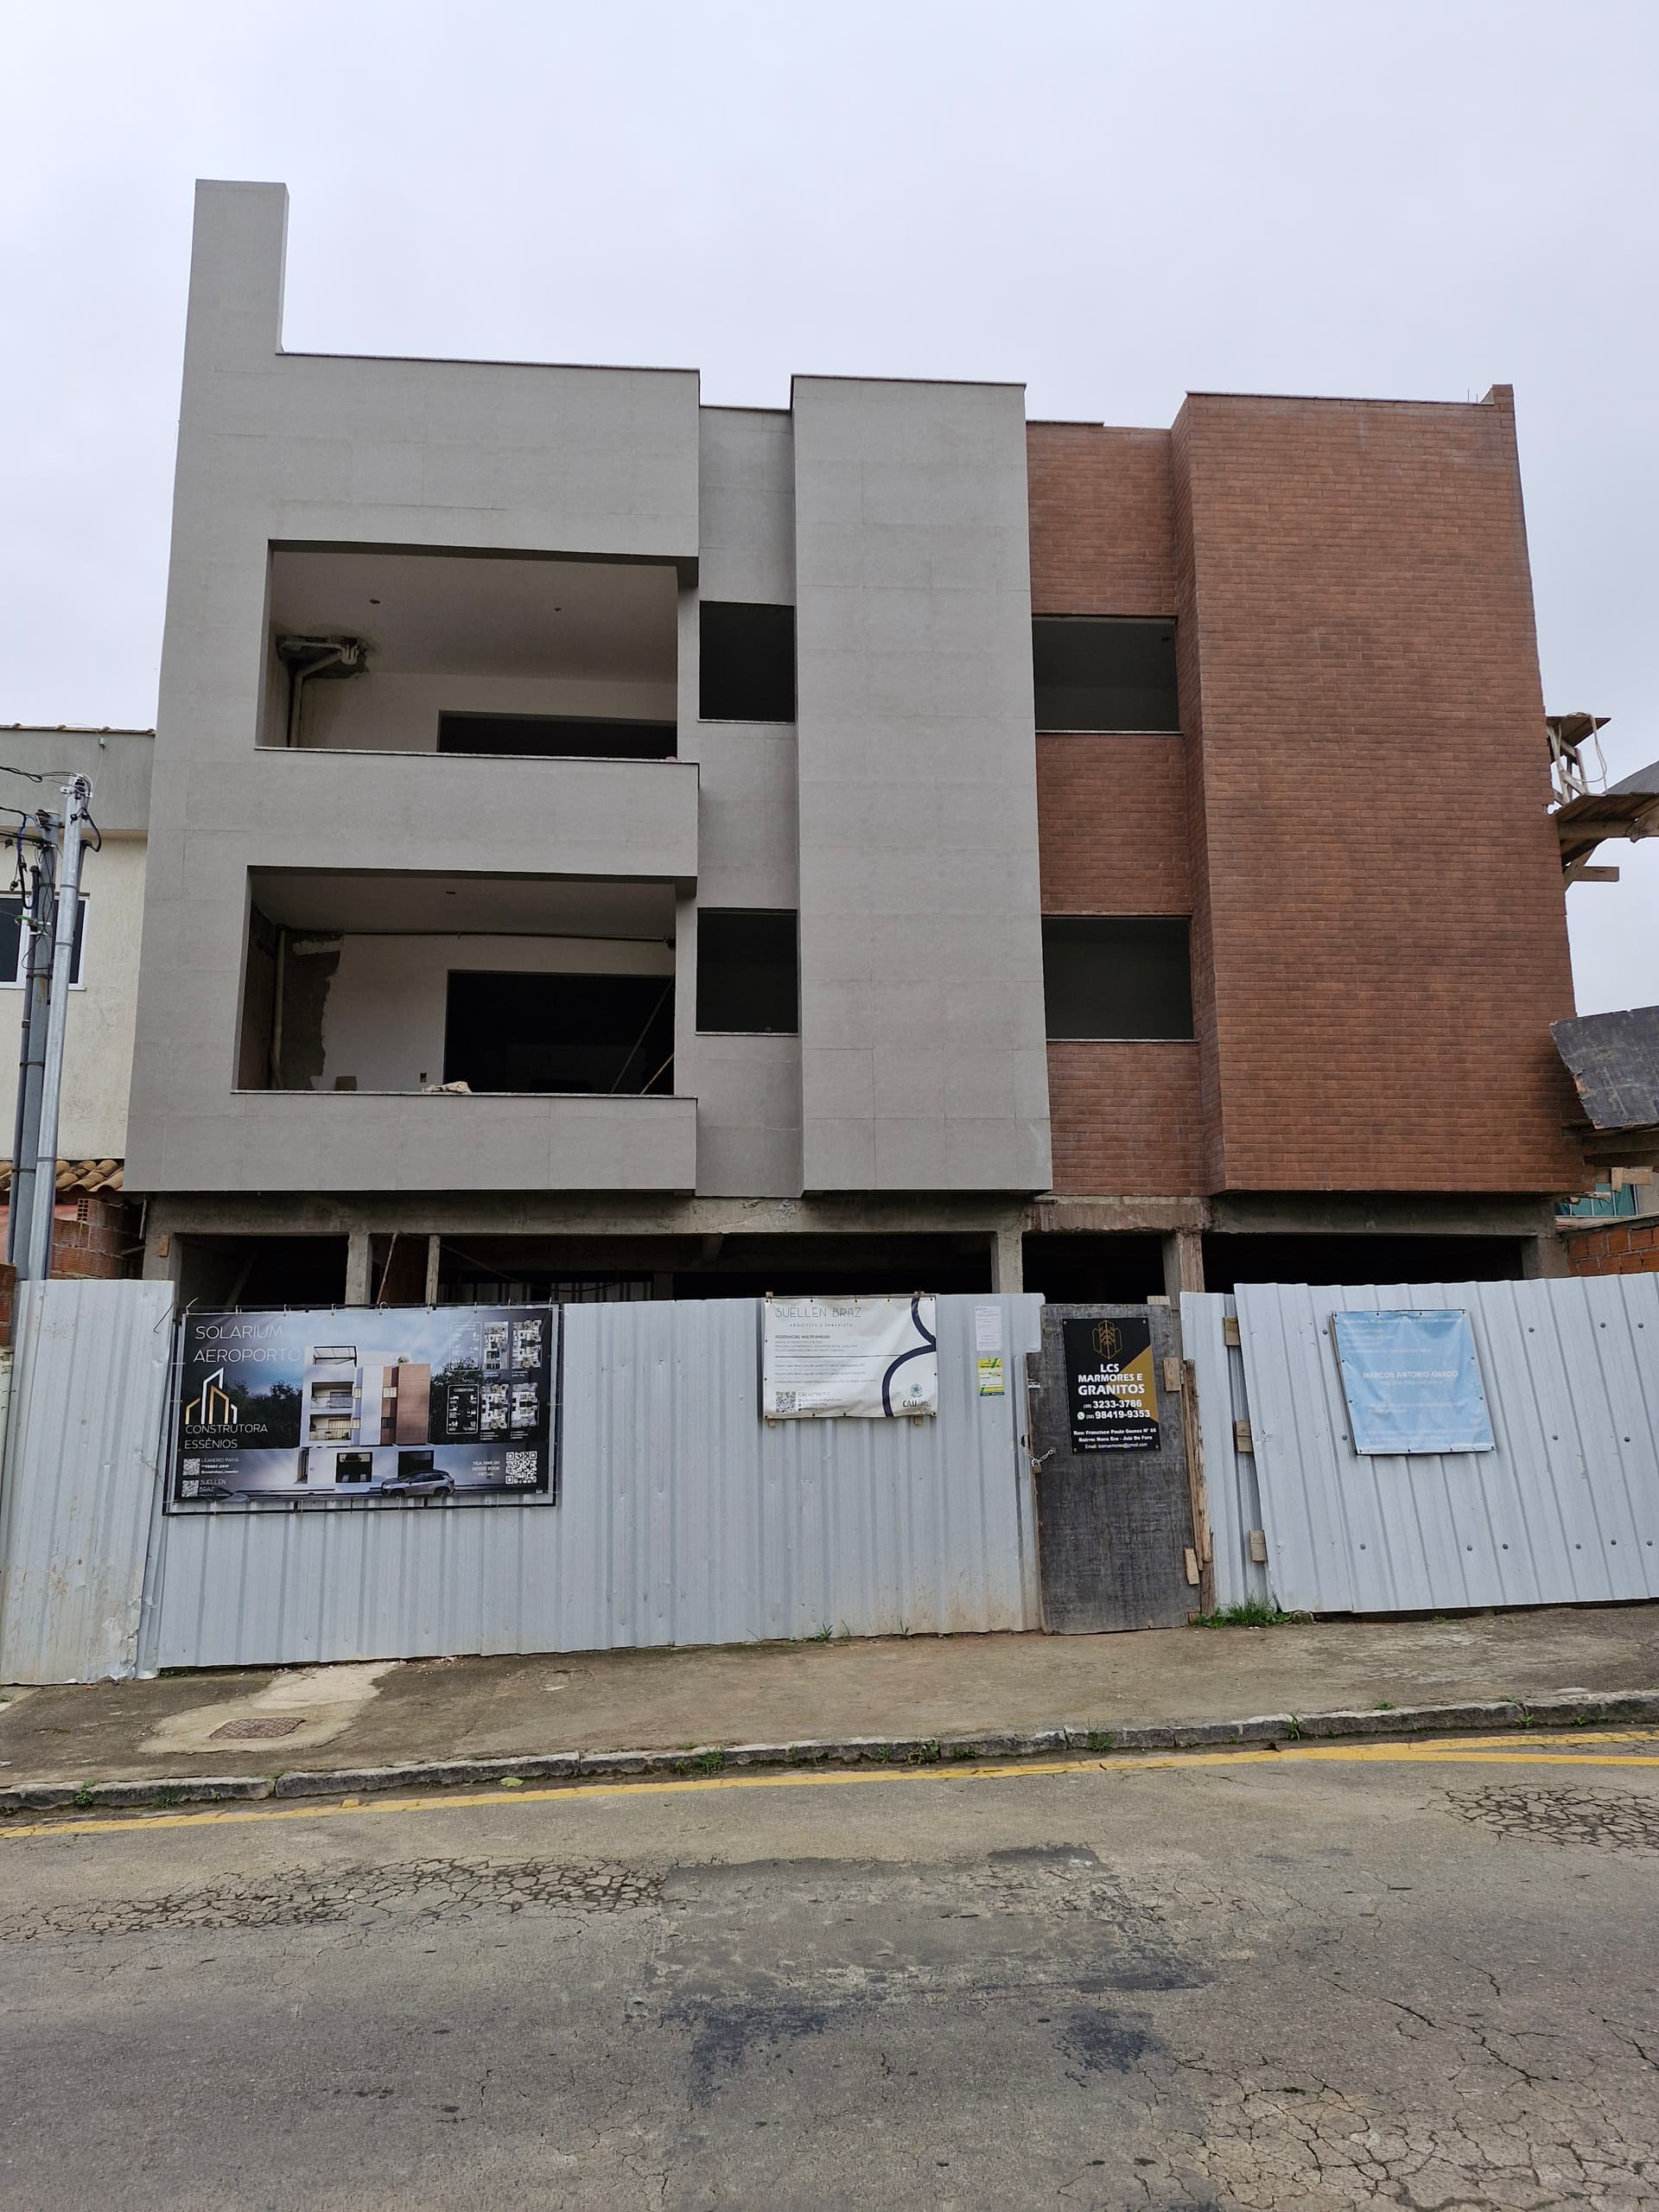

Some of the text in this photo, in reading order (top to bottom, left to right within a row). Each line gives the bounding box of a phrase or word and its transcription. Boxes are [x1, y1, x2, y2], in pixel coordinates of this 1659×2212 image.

[775, 1306, 862, 1318] SUELLEN BRAZ
[194, 1325, 283, 1339] SOLARIUM
[193, 1349, 302, 1363] AEROPORTO
[1100, 1363, 1120, 1372] LCS
[1077, 1374, 1135, 1382] MARMORES
[1077, 1383, 1145, 1395] GRANITOS
[1092, 1399, 1142, 1408] 3233-3786
[1095, 1409, 1151, 1420] 98419-9353
[185, 1424, 269, 1434] CONSTRUTORA
